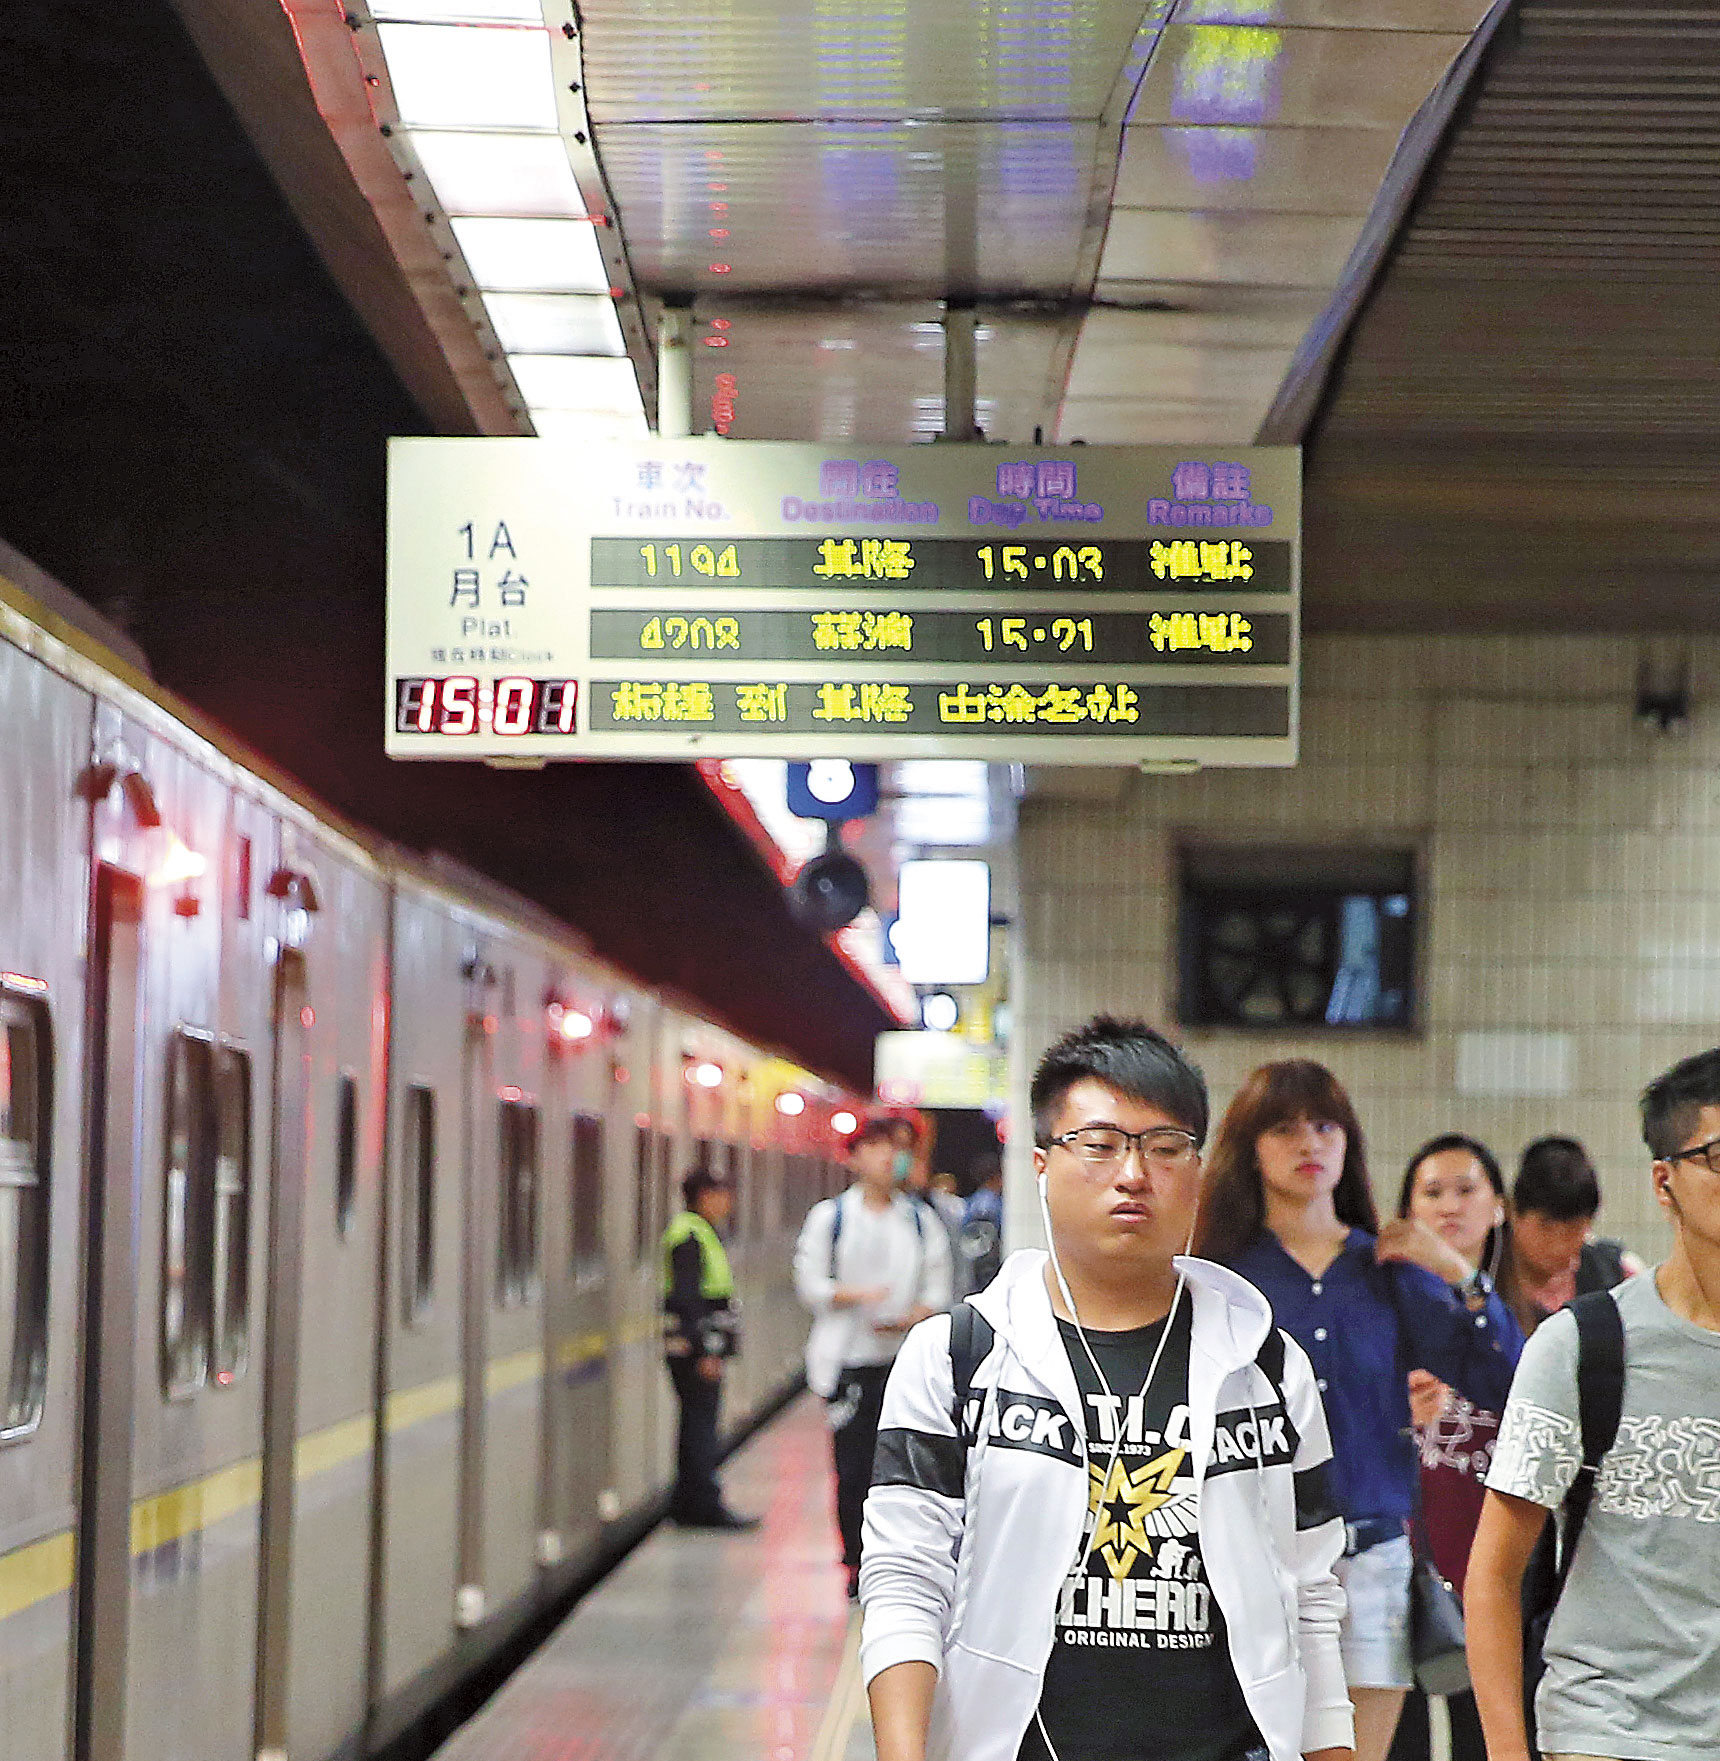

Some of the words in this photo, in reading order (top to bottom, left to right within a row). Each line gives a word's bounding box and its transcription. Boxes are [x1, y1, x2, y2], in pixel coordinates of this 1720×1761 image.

[613, 498, 678, 520] Train
[685, 498, 731, 521] No.
[781, 496, 939, 525] Destination
[1034, 499, 1105, 523] Time
[1147, 498, 1274, 528] Remarks
[458, 521, 517, 560] 1A
[450, 569, 529, 607] 月台
[417, 676, 579, 736] 15:01
[735, 682, 788, 721] 到
[1207, 1416, 1290, 1467] ACK
[1064, 1629, 1151, 1649] ORIGINAL
